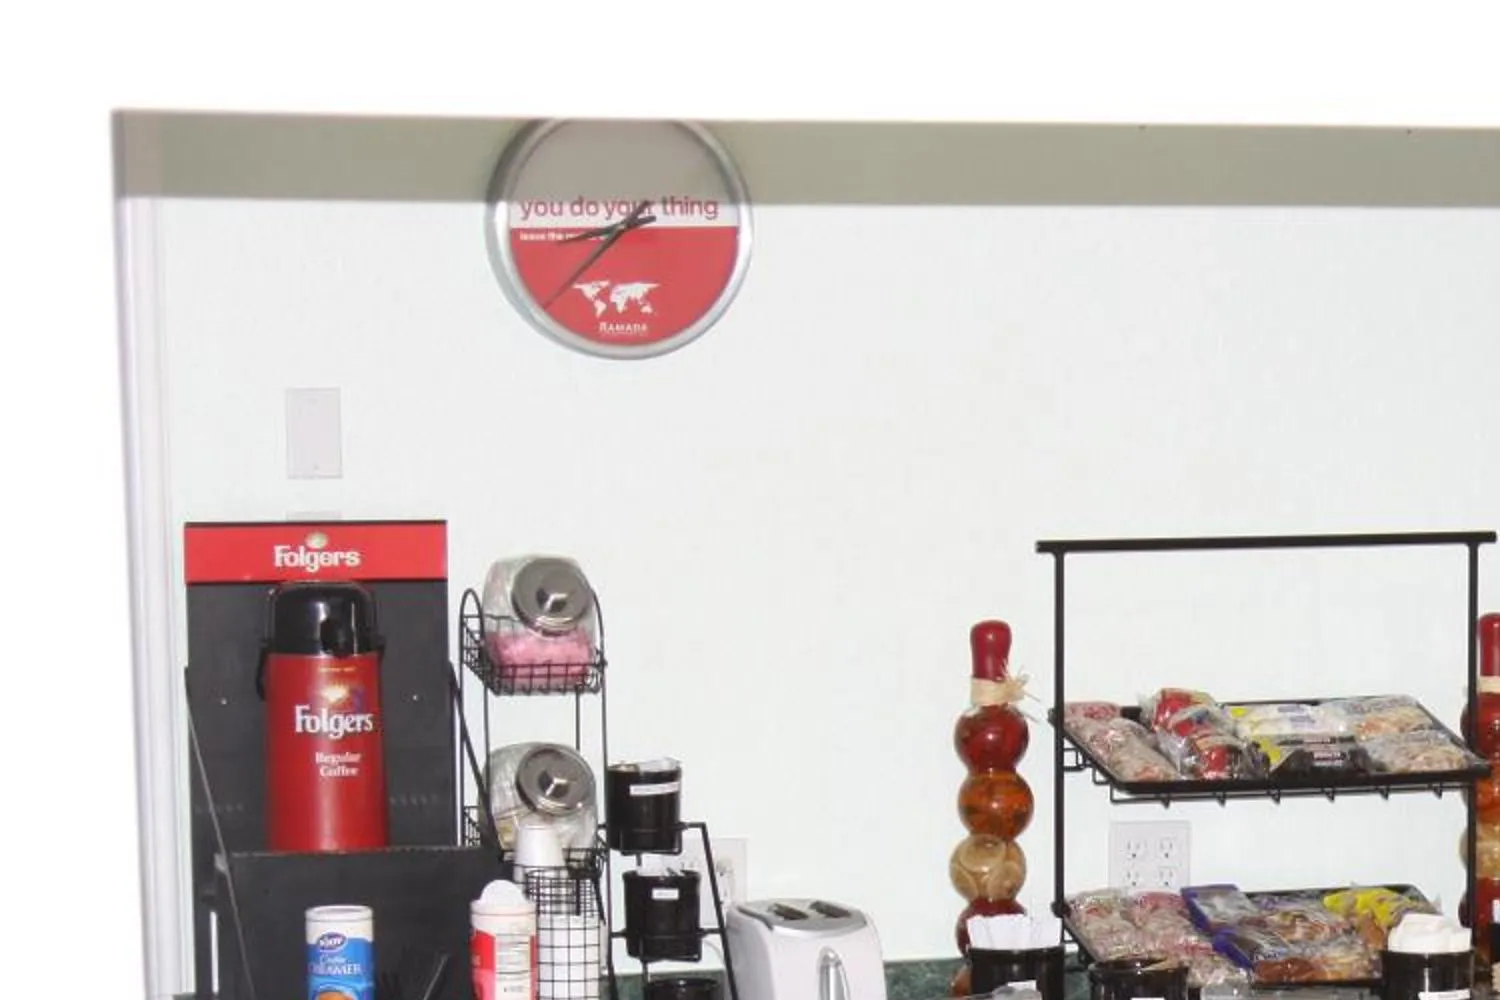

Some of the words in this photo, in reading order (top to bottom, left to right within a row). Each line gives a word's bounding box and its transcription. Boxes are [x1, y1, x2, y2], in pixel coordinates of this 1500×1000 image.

[520, 201, 563, 220] you
[570, 196, 599, 216] do
[662, 196, 718, 219] thing
[273, 545, 361, 573] Folgers
[294, 704, 374, 740] Folgers
[315, 751, 361, 765] Regular
[319, 765, 359, 777] Coffee
